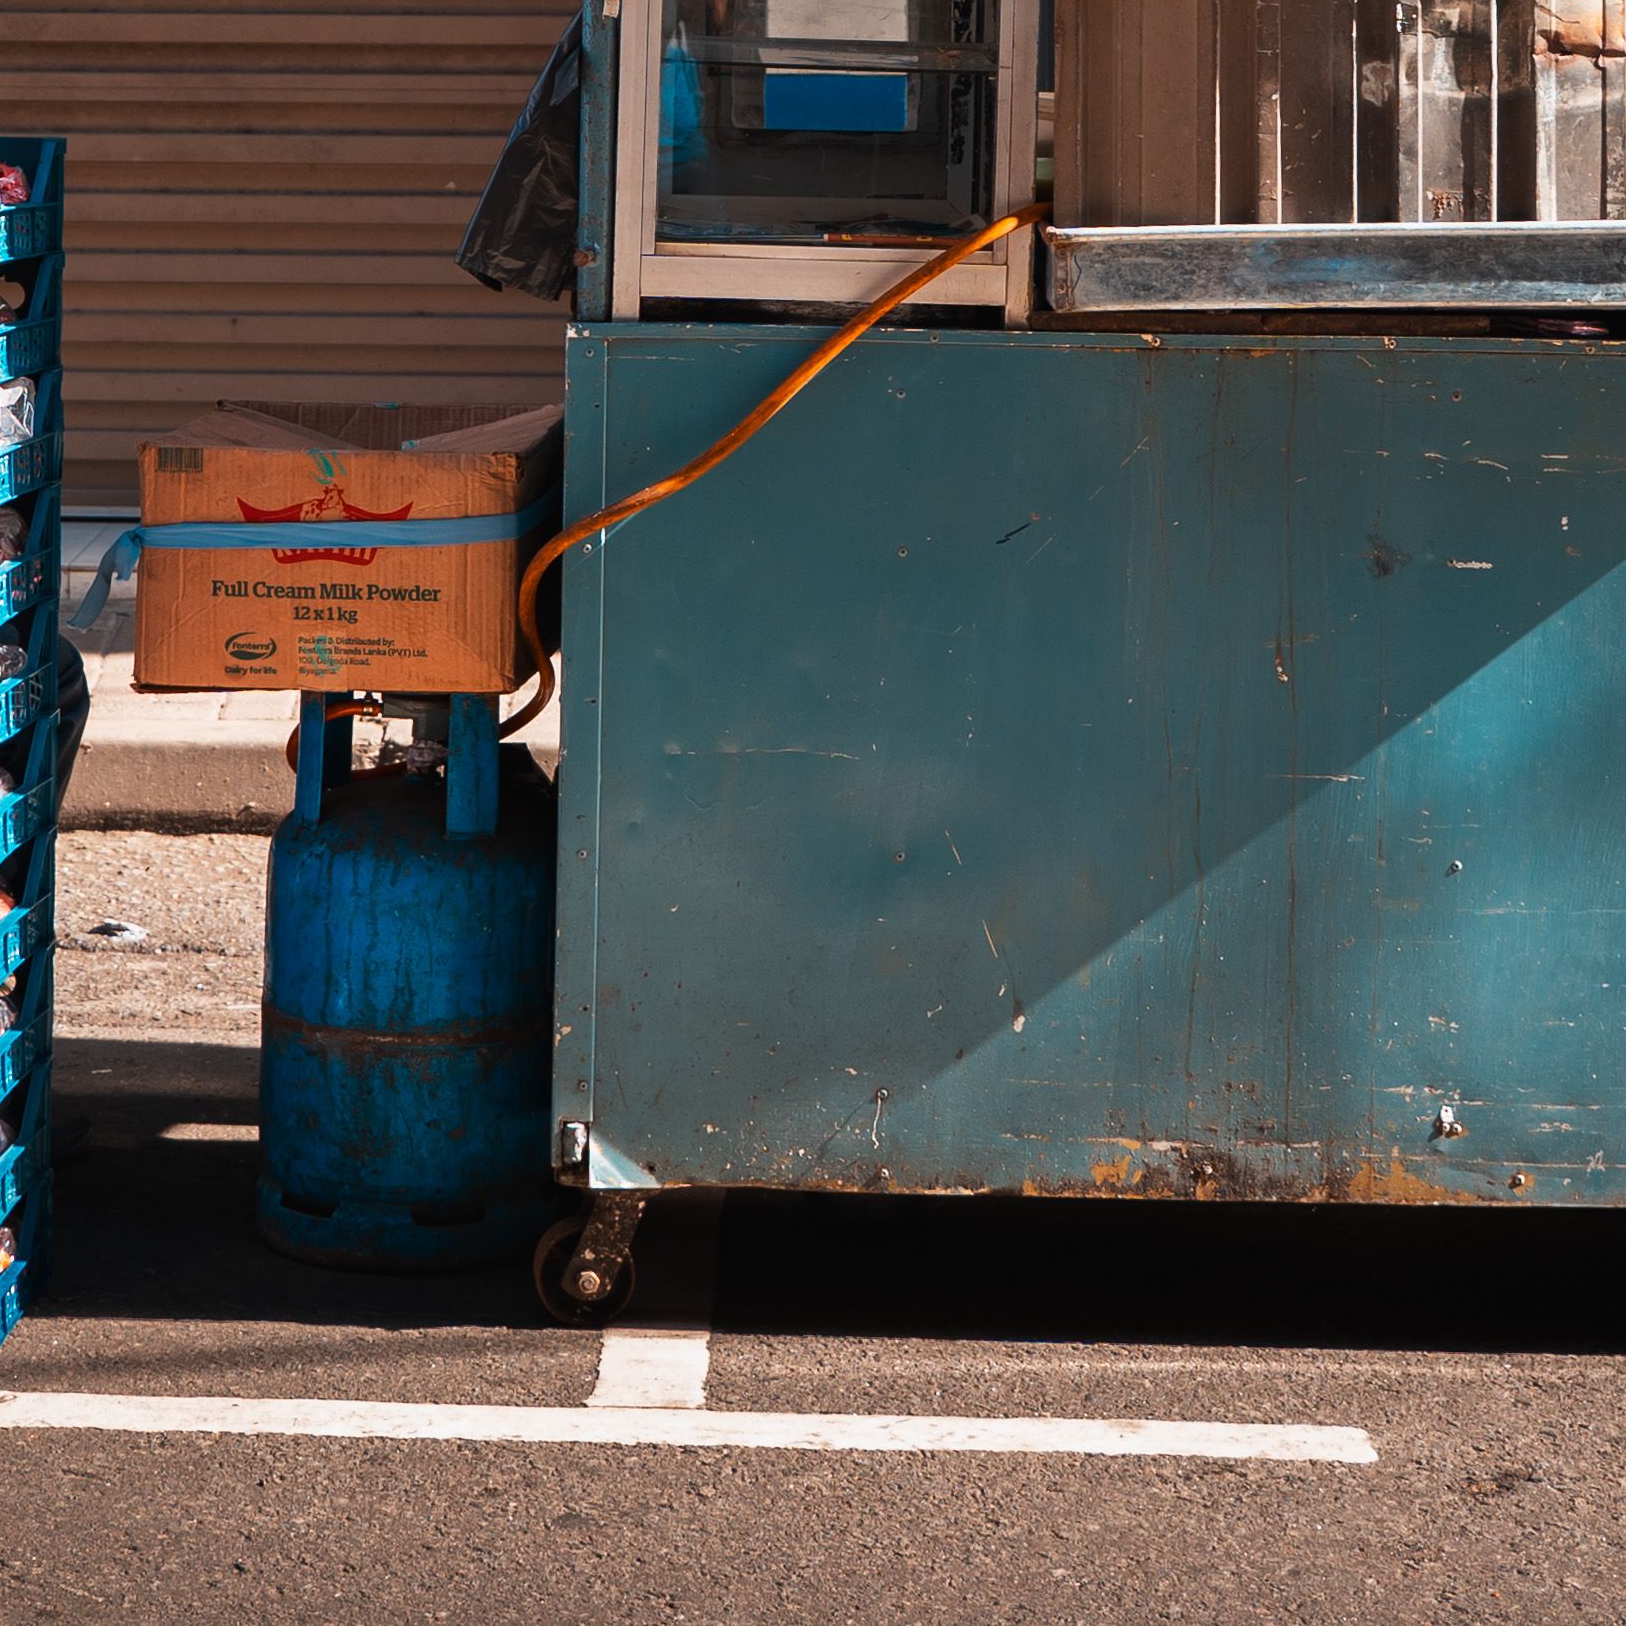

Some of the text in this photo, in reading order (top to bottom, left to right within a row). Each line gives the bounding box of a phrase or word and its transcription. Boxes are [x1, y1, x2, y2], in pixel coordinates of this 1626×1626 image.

[211, 580, 441, 602] Full Cream Milk Powder
[293, 606, 311, 620] 12
[313, 610, 325, 620] x
[337, 607, 358, 624] kg
[336, 637, 381, 646] Distributed
[333, 647, 362, 655] Brands
[363, 647, 386, 656] Lanka
[388, 648, 411, 657] (PVT)
[250, 666, 262, 674] for
[263, 666, 277, 674] life
